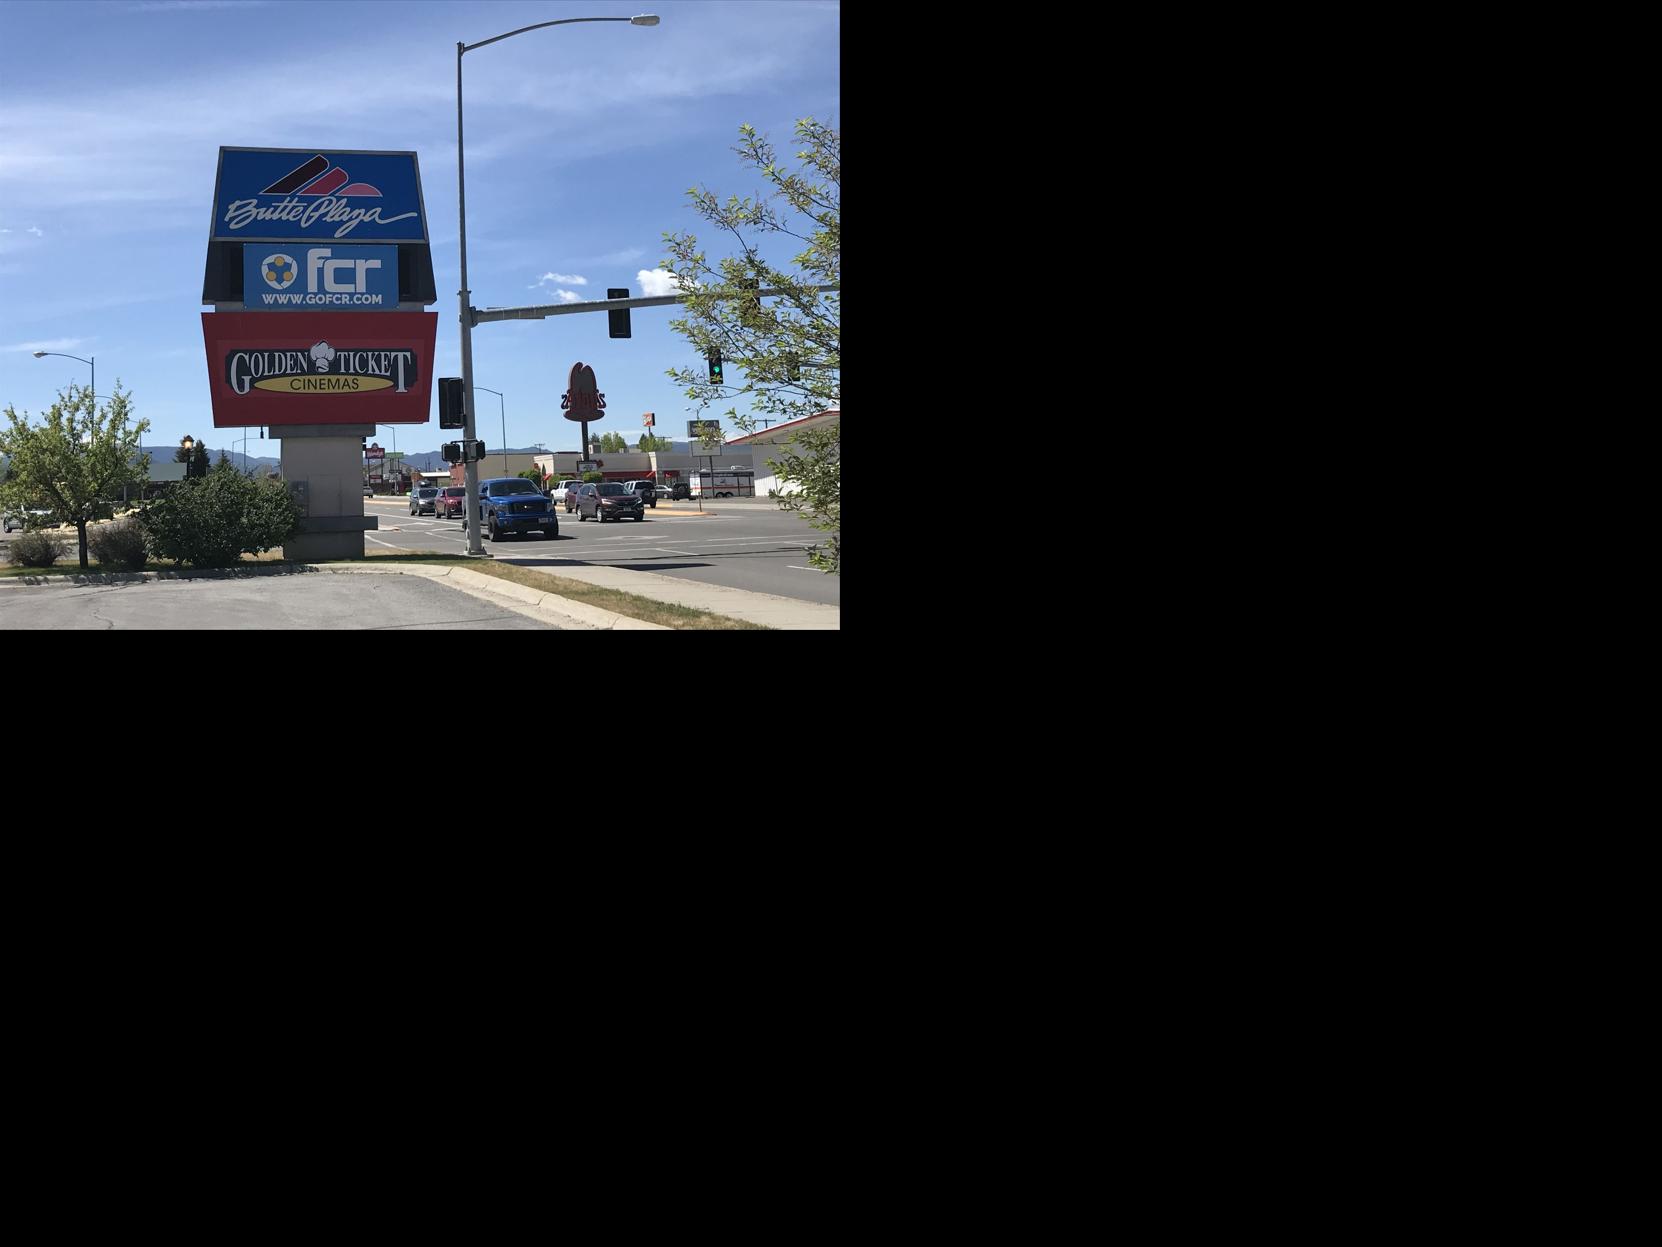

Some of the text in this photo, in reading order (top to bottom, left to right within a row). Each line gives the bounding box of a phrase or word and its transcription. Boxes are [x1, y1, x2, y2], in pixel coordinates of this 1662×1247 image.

[224, 196, 418, 238] Butte Plaza
[307, 248, 382, 293] fcr
[262, 293, 382, 305] WWW.GOFCR.COM
[230, 352, 411, 395] GOLDEN TICKET
[290, 377, 359, 391] CINEMAS
